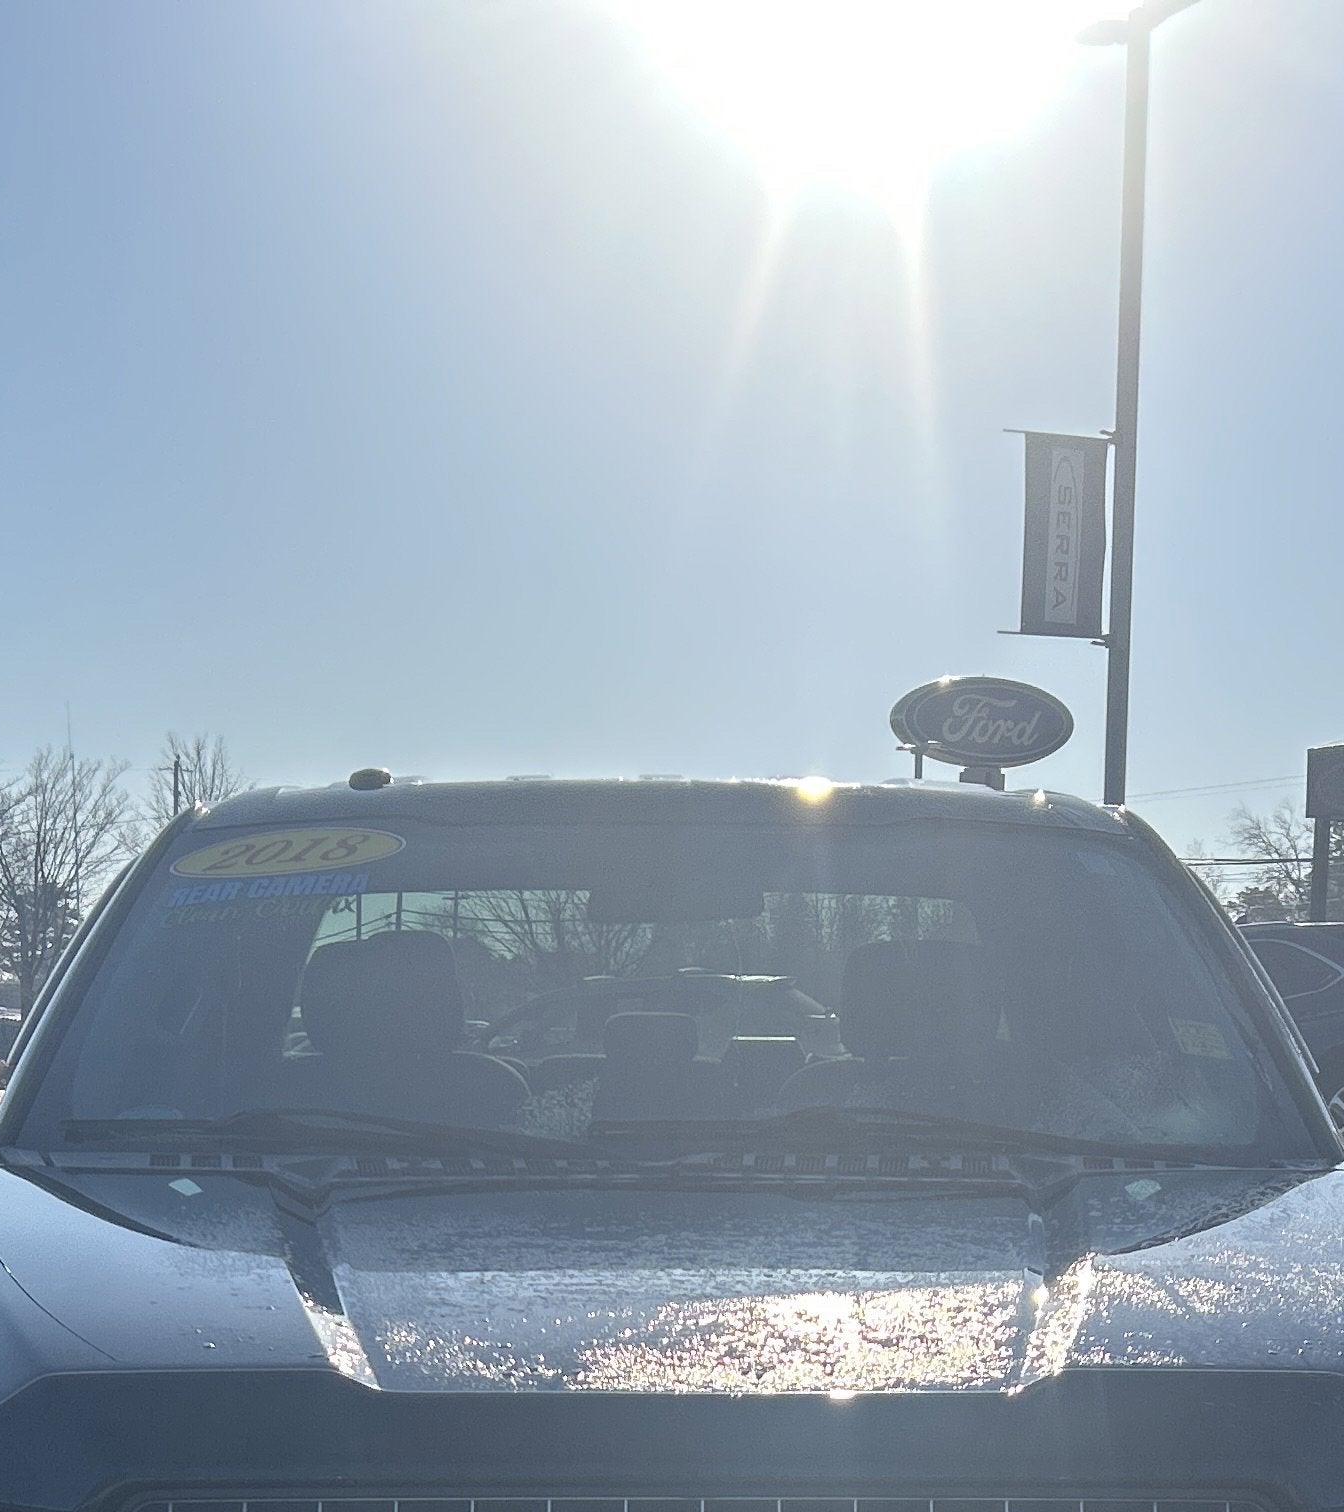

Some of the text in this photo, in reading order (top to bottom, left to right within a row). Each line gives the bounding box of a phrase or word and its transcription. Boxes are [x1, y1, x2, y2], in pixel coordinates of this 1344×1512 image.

[1052, 485, 1073, 610] SERRA
[942, 694, 1042, 747] Ford
[201, 833, 370, 873] 2018
[166, 873, 370, 908] REAR CAMERA
